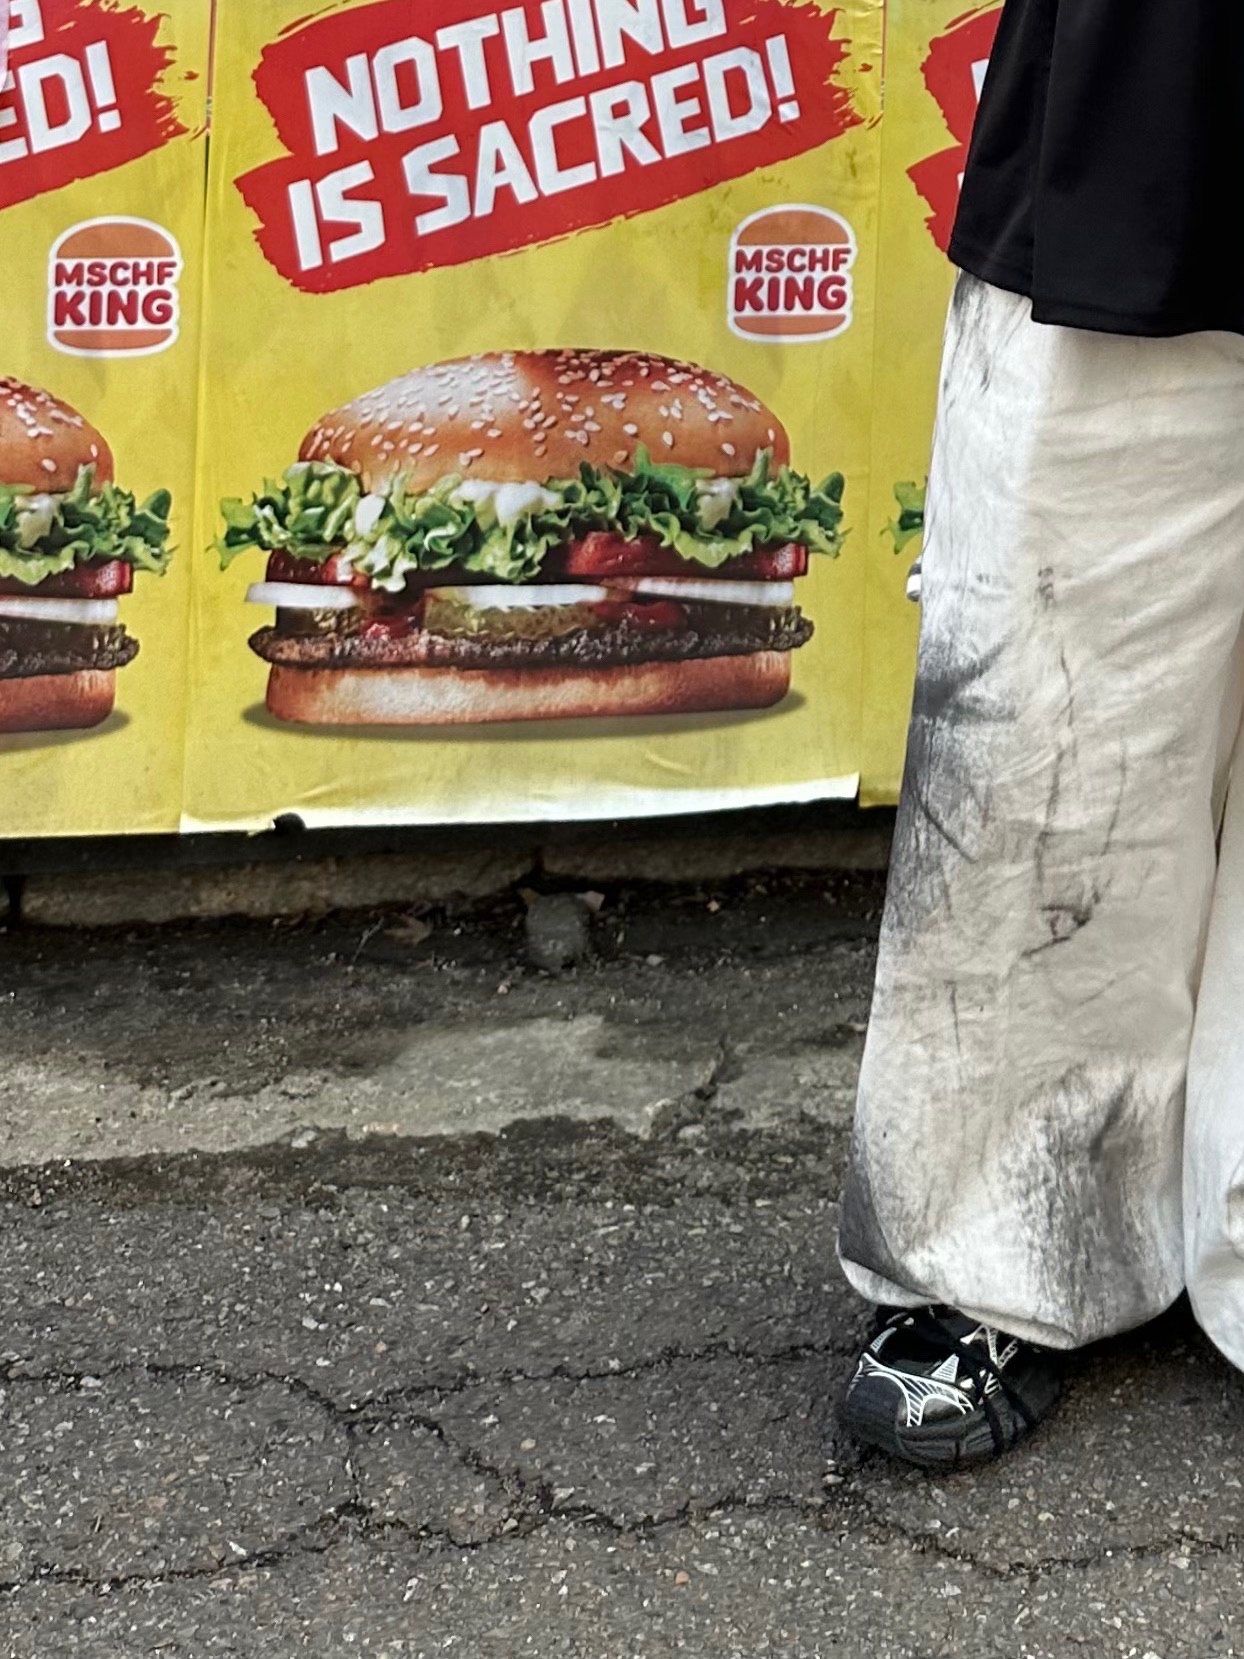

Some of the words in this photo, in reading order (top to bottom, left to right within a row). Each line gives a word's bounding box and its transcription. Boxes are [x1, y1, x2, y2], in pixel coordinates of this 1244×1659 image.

[287, 159, 387, 272] IS
[402, 34, 802, 236] SACRED!
[55, 261, 177, 287] MSCHF
[736, 247, 849, 272] MSCHF
[54, 289, 174, 326] KING
[735, 276, 850, 311] KING
